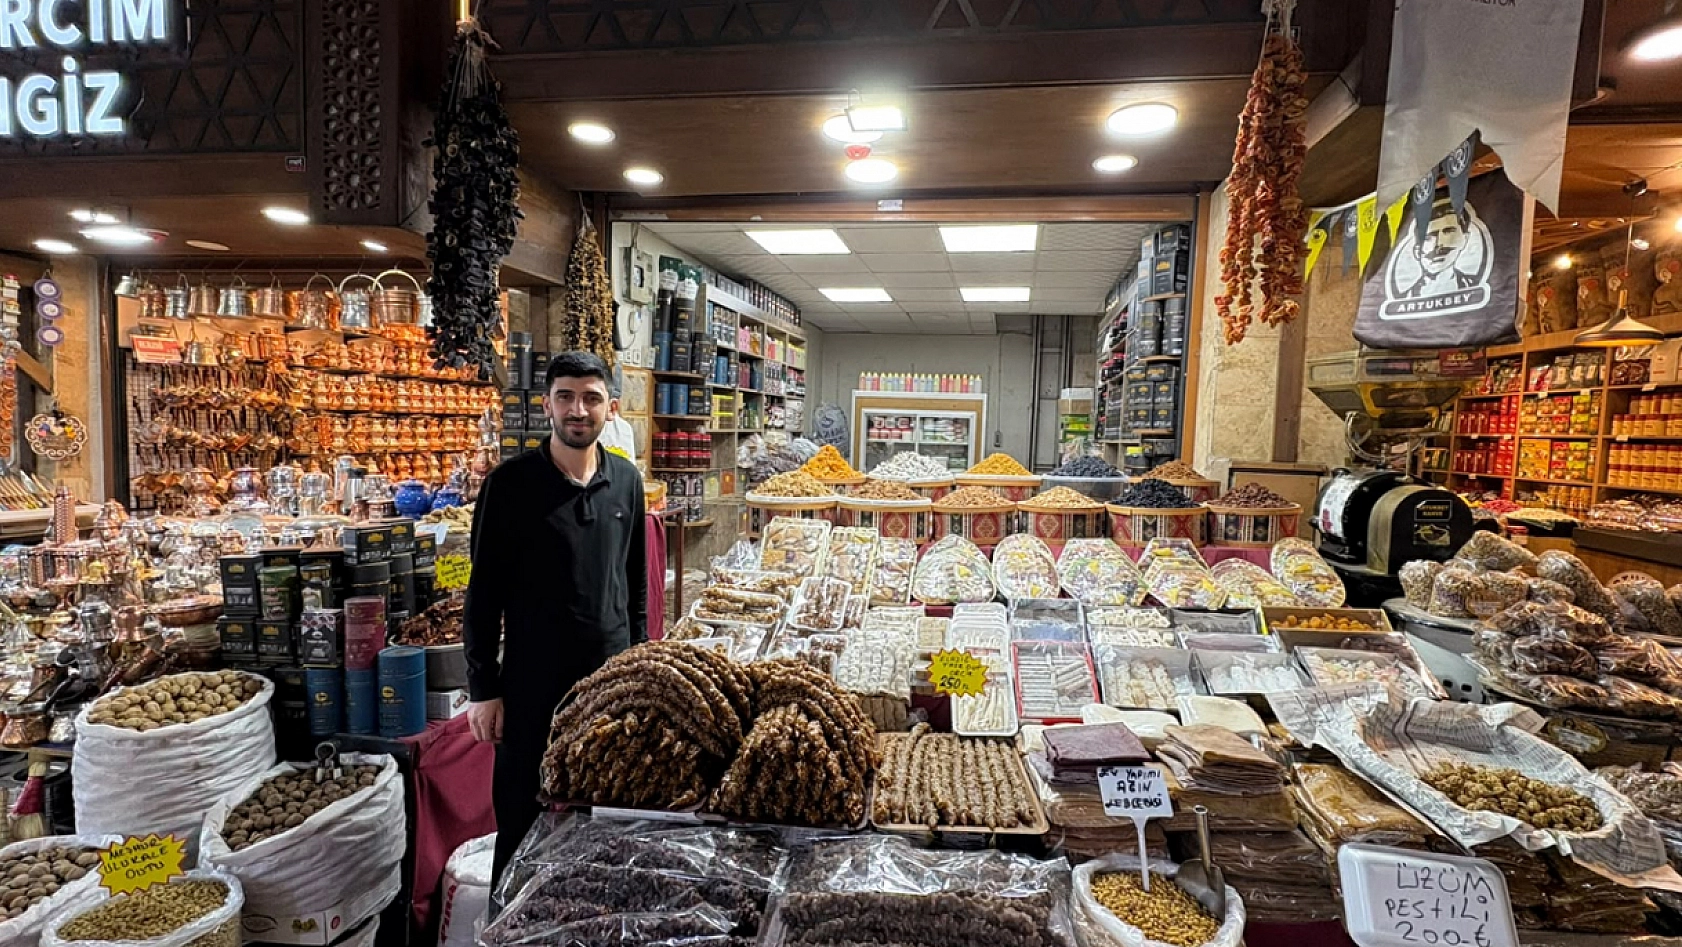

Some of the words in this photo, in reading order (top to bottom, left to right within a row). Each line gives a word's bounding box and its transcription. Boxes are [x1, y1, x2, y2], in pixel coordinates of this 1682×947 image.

[1396, 291, 1474, 313] ARTUKBEY
[939, 674, 961, 690] 250
[1397, 862, 1495, 901] ÜZÜM
